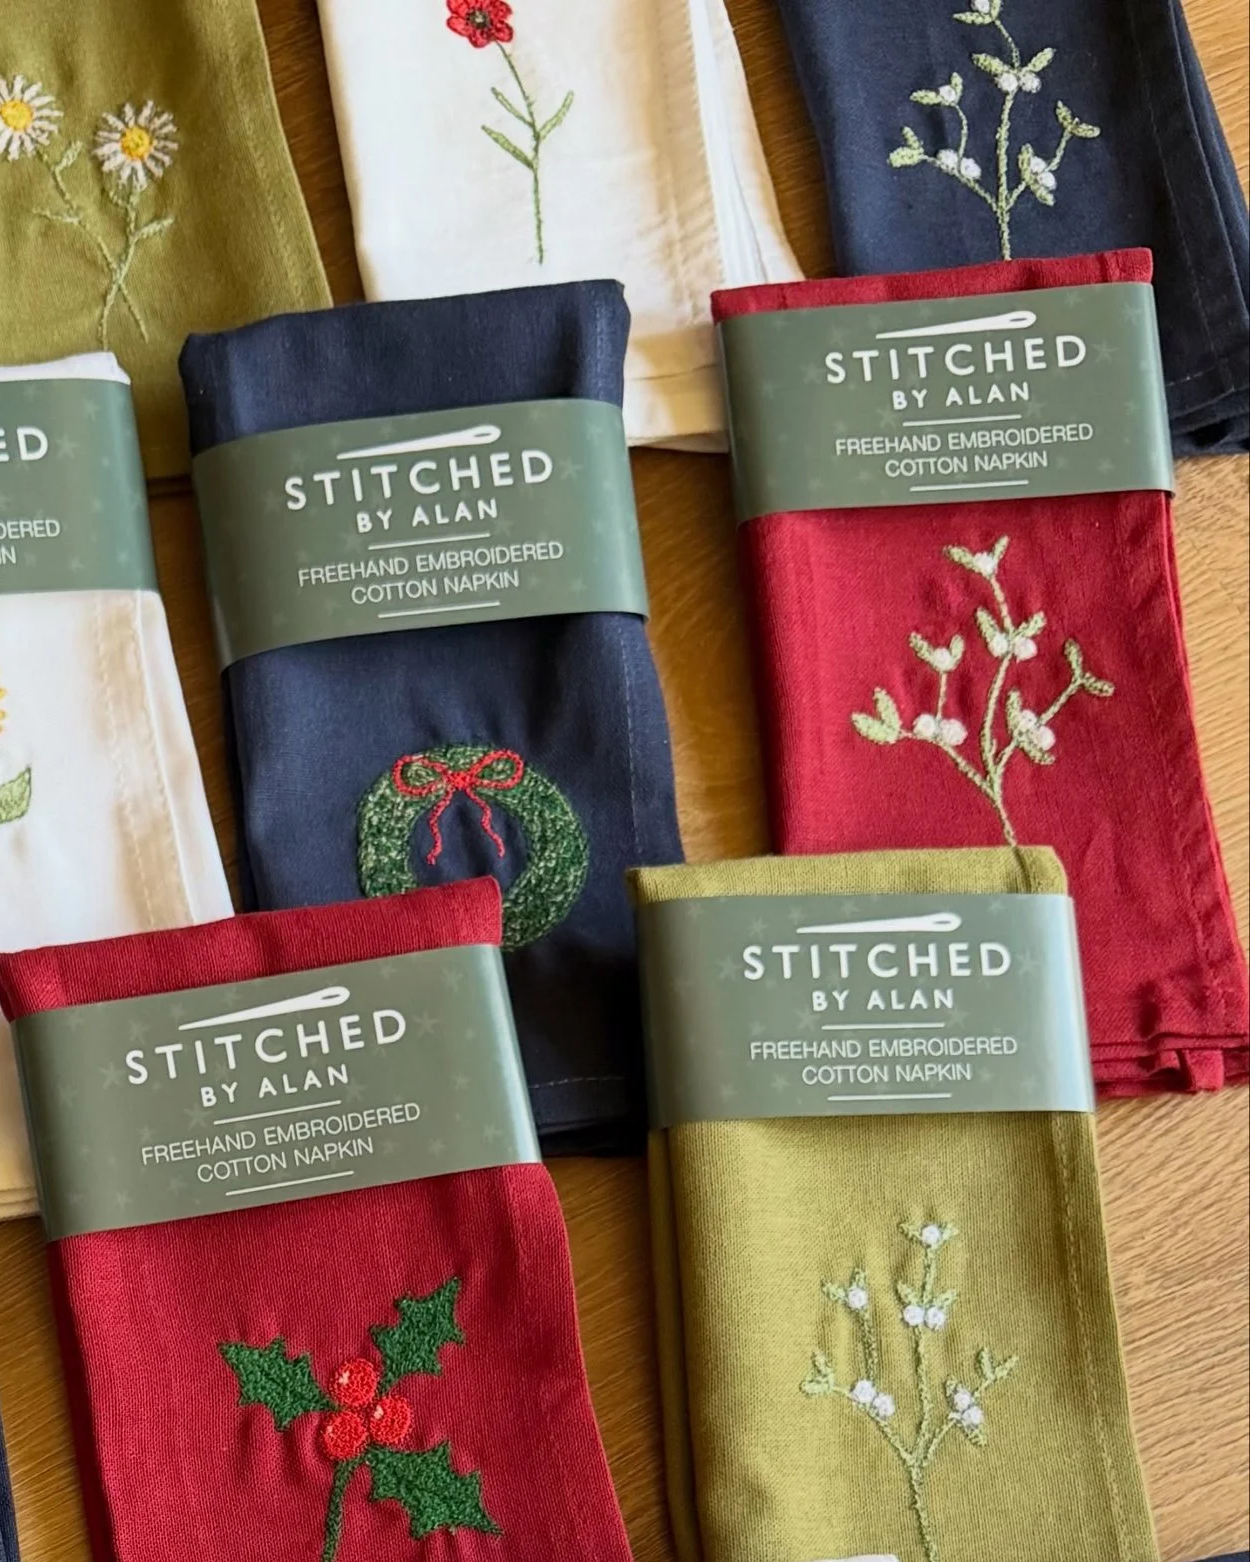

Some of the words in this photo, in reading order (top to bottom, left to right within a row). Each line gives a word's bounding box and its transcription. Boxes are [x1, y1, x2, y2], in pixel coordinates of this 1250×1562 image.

[825, 335, 1086, 384] STITCHED
[893, 388, 928, 410] BY
[945, 381, 1029, 407] ALAN
[835, 434, 941, 456] FREEHAND
[948, 423, 1093, 450] EMBROIDERED
[285, 450, 553, 510] STITCHED
[885, 456, 968, 477] COTTON
[974, 450, 1048, 472] NAPKIN
[357, 508, 392, 533] BY
[412, 497, 497, 527] ALAN
[298, 557, 409, 587] FREEHAND
[416, 541, 564, 573] EMBROIDERED
[351, 578, 438, 604] COTTON
[443, 569, 519, 594] NAPKIN
[743, 943, 1011, 980] STITCHED
[812, 990, 849, 1011] BY
[867, 989, 953, 1010] ALAN
[125, 1009, 406, 1085] STITCHED
[750, 1040, 862, 1060] FREEHAND
[868, 1036, 1017, 1057] EMBROIDERED
[200, 1081, 238, 1107] BY
[259, 1063, 348, 1098] ALAN
[802, 1065, 888, 1085] COTTON
[896, 1063, 971, 1082] NAPKIN
[141, 1131, 256, 1165] FREEHAND
[263, 1102, 420, 1146] EMBROIDERED
[197, 1151, 287, 1183] COTTON
[293, 1136, 374, 1167] NAPKIN
